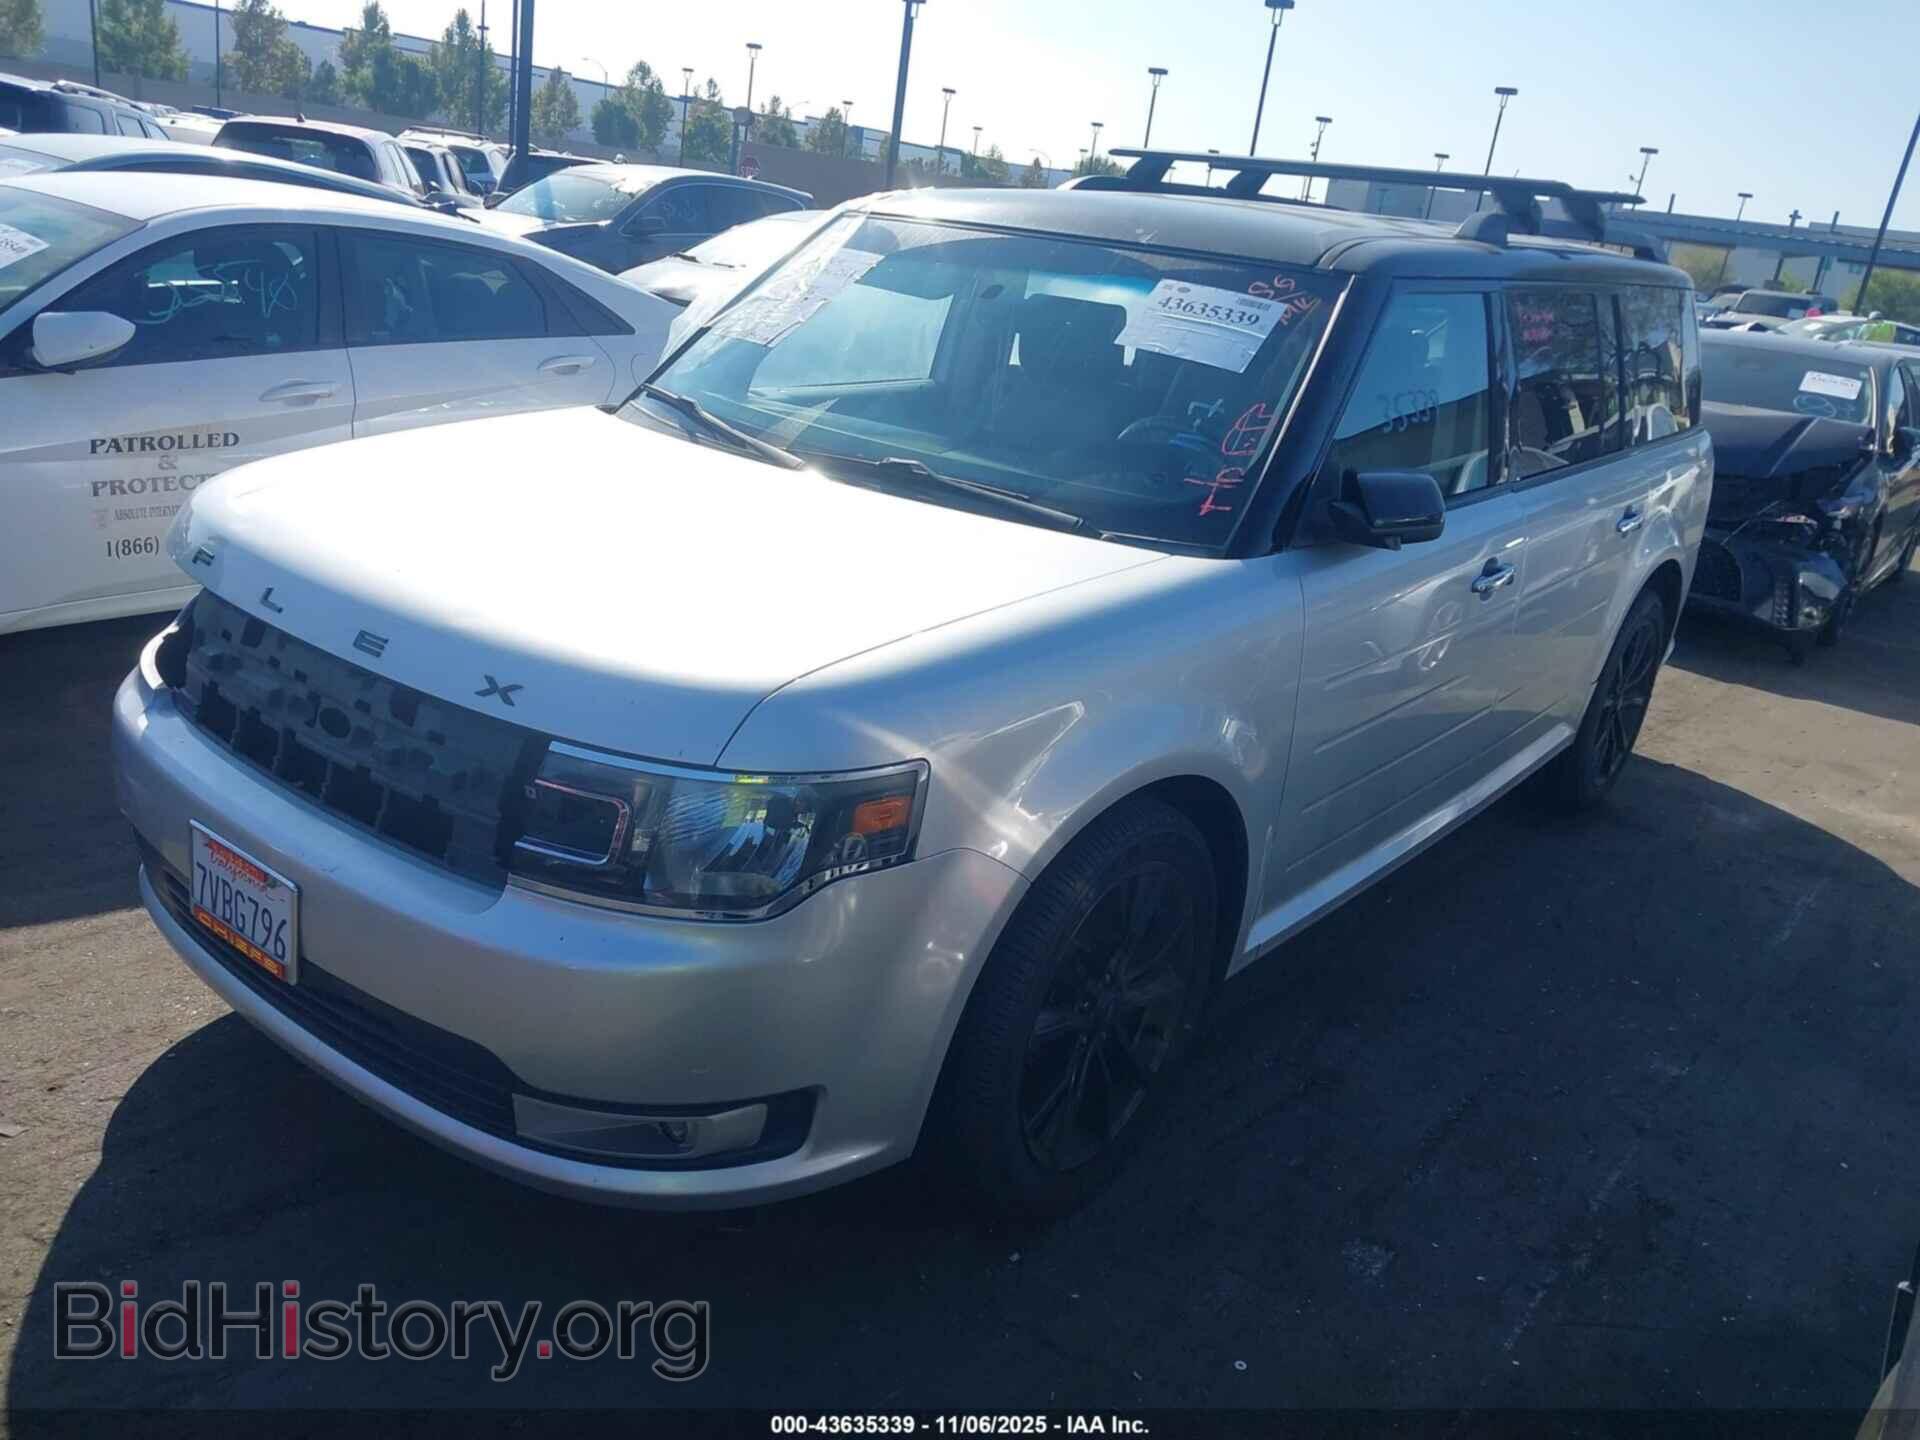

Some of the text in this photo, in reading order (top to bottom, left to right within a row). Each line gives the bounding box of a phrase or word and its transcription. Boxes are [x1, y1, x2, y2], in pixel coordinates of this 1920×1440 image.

[1156, 296, 1260, 327] 43635339
[89, 432, 240, 454] PATROLLED
[158, 455, 178, 470] &
[91, 473, 218, 497] PROTECT
[106, 535, 160, 560] 1(866)
[196, 861, 288, 962] 7VBG796
